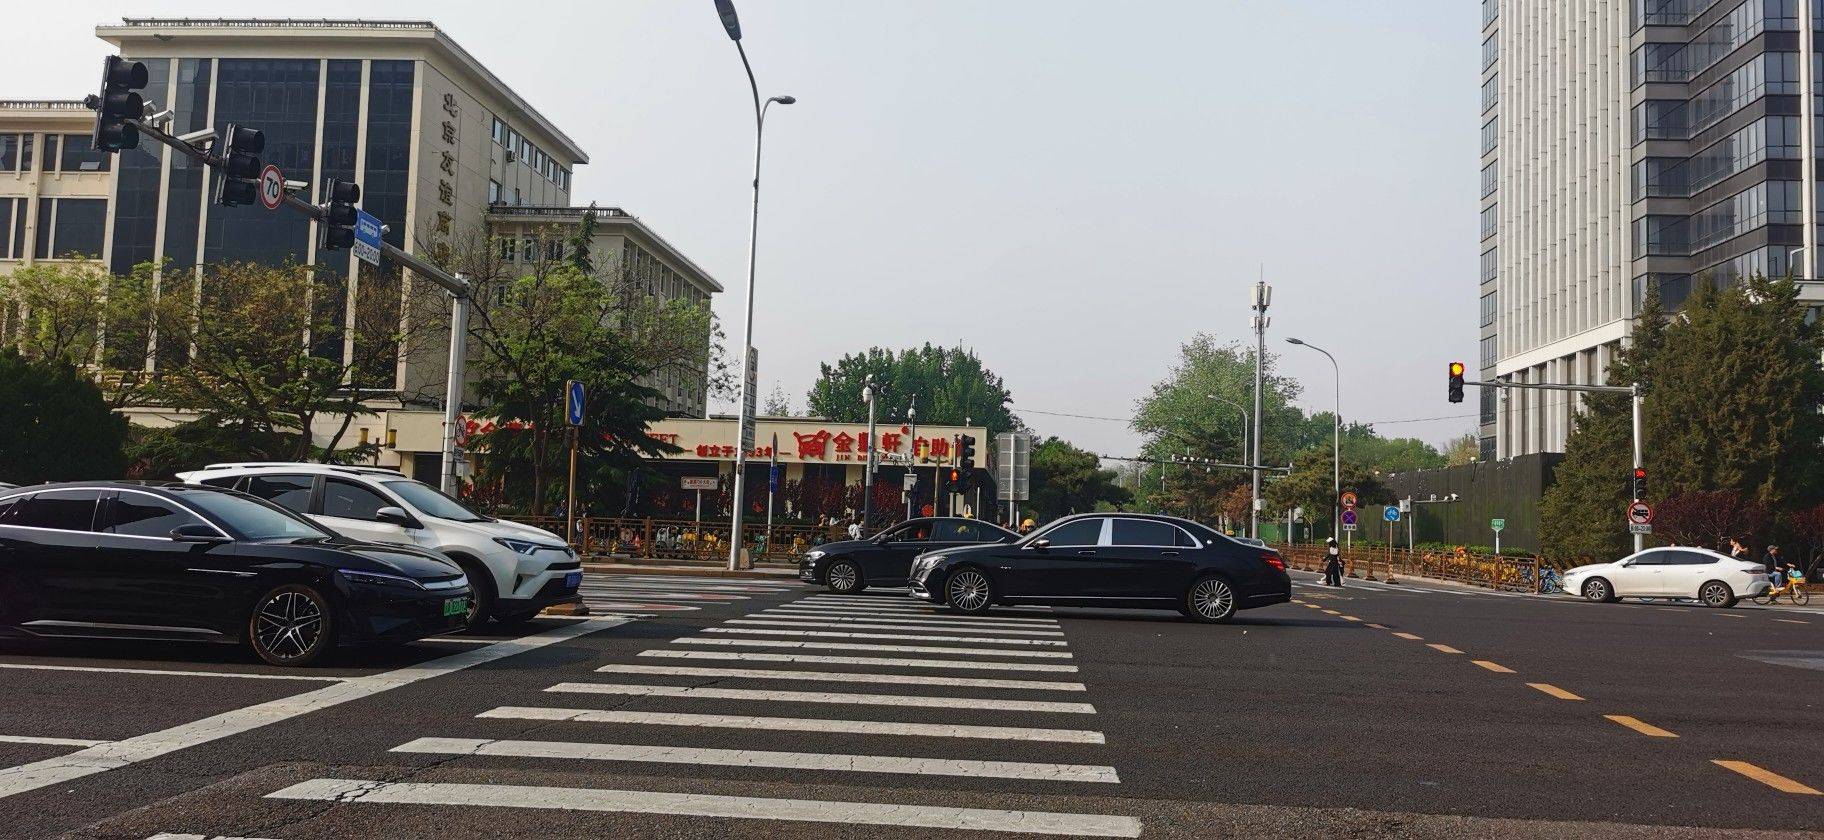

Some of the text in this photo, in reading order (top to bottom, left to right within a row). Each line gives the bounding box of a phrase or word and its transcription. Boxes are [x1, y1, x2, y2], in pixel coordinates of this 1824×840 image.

[266, 176, 279, 198] 70
[696, 444, 773, 458] 创立于3年
[836, 454, 851, 462] JIN
